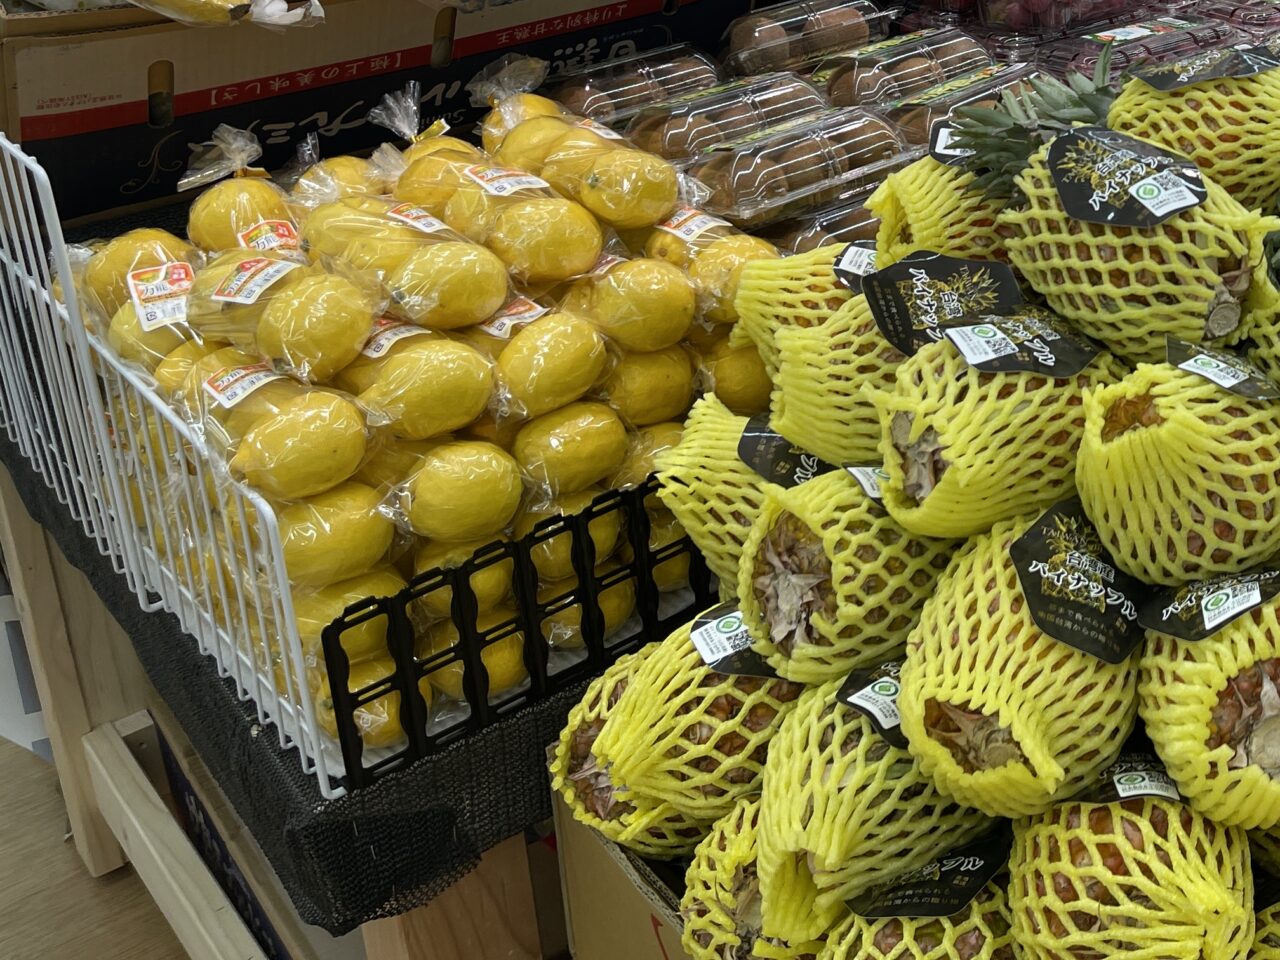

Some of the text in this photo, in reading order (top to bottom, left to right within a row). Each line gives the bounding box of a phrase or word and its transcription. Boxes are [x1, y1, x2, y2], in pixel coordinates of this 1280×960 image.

[1066, 550, 1116, 583] 台湾産
[1028, 560, 1137, 621] パイナップル
